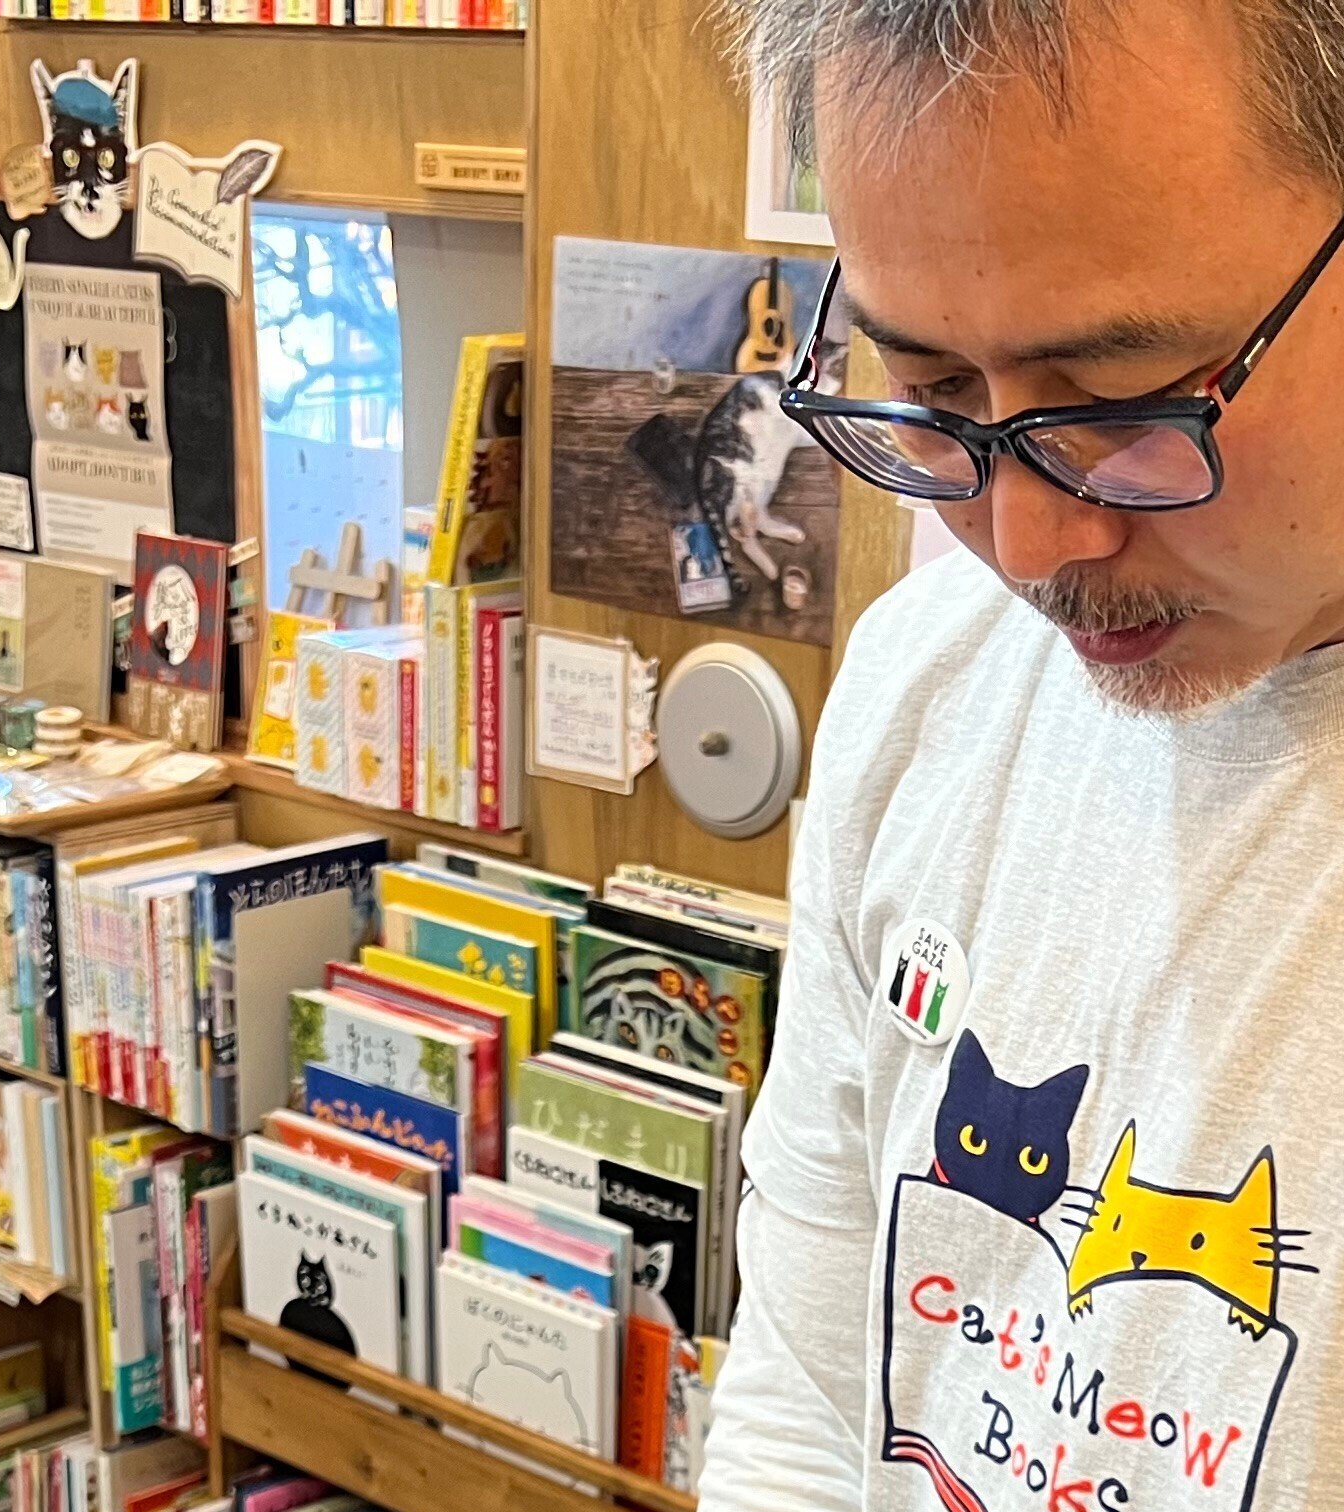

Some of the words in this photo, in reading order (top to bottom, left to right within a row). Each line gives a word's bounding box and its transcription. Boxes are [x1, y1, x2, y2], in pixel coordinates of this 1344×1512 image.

[911, 941, 944, 972] GAZA
[917, 927, 948, 958] SAVE
[909, 1274, 1049, 1386] Cat's
